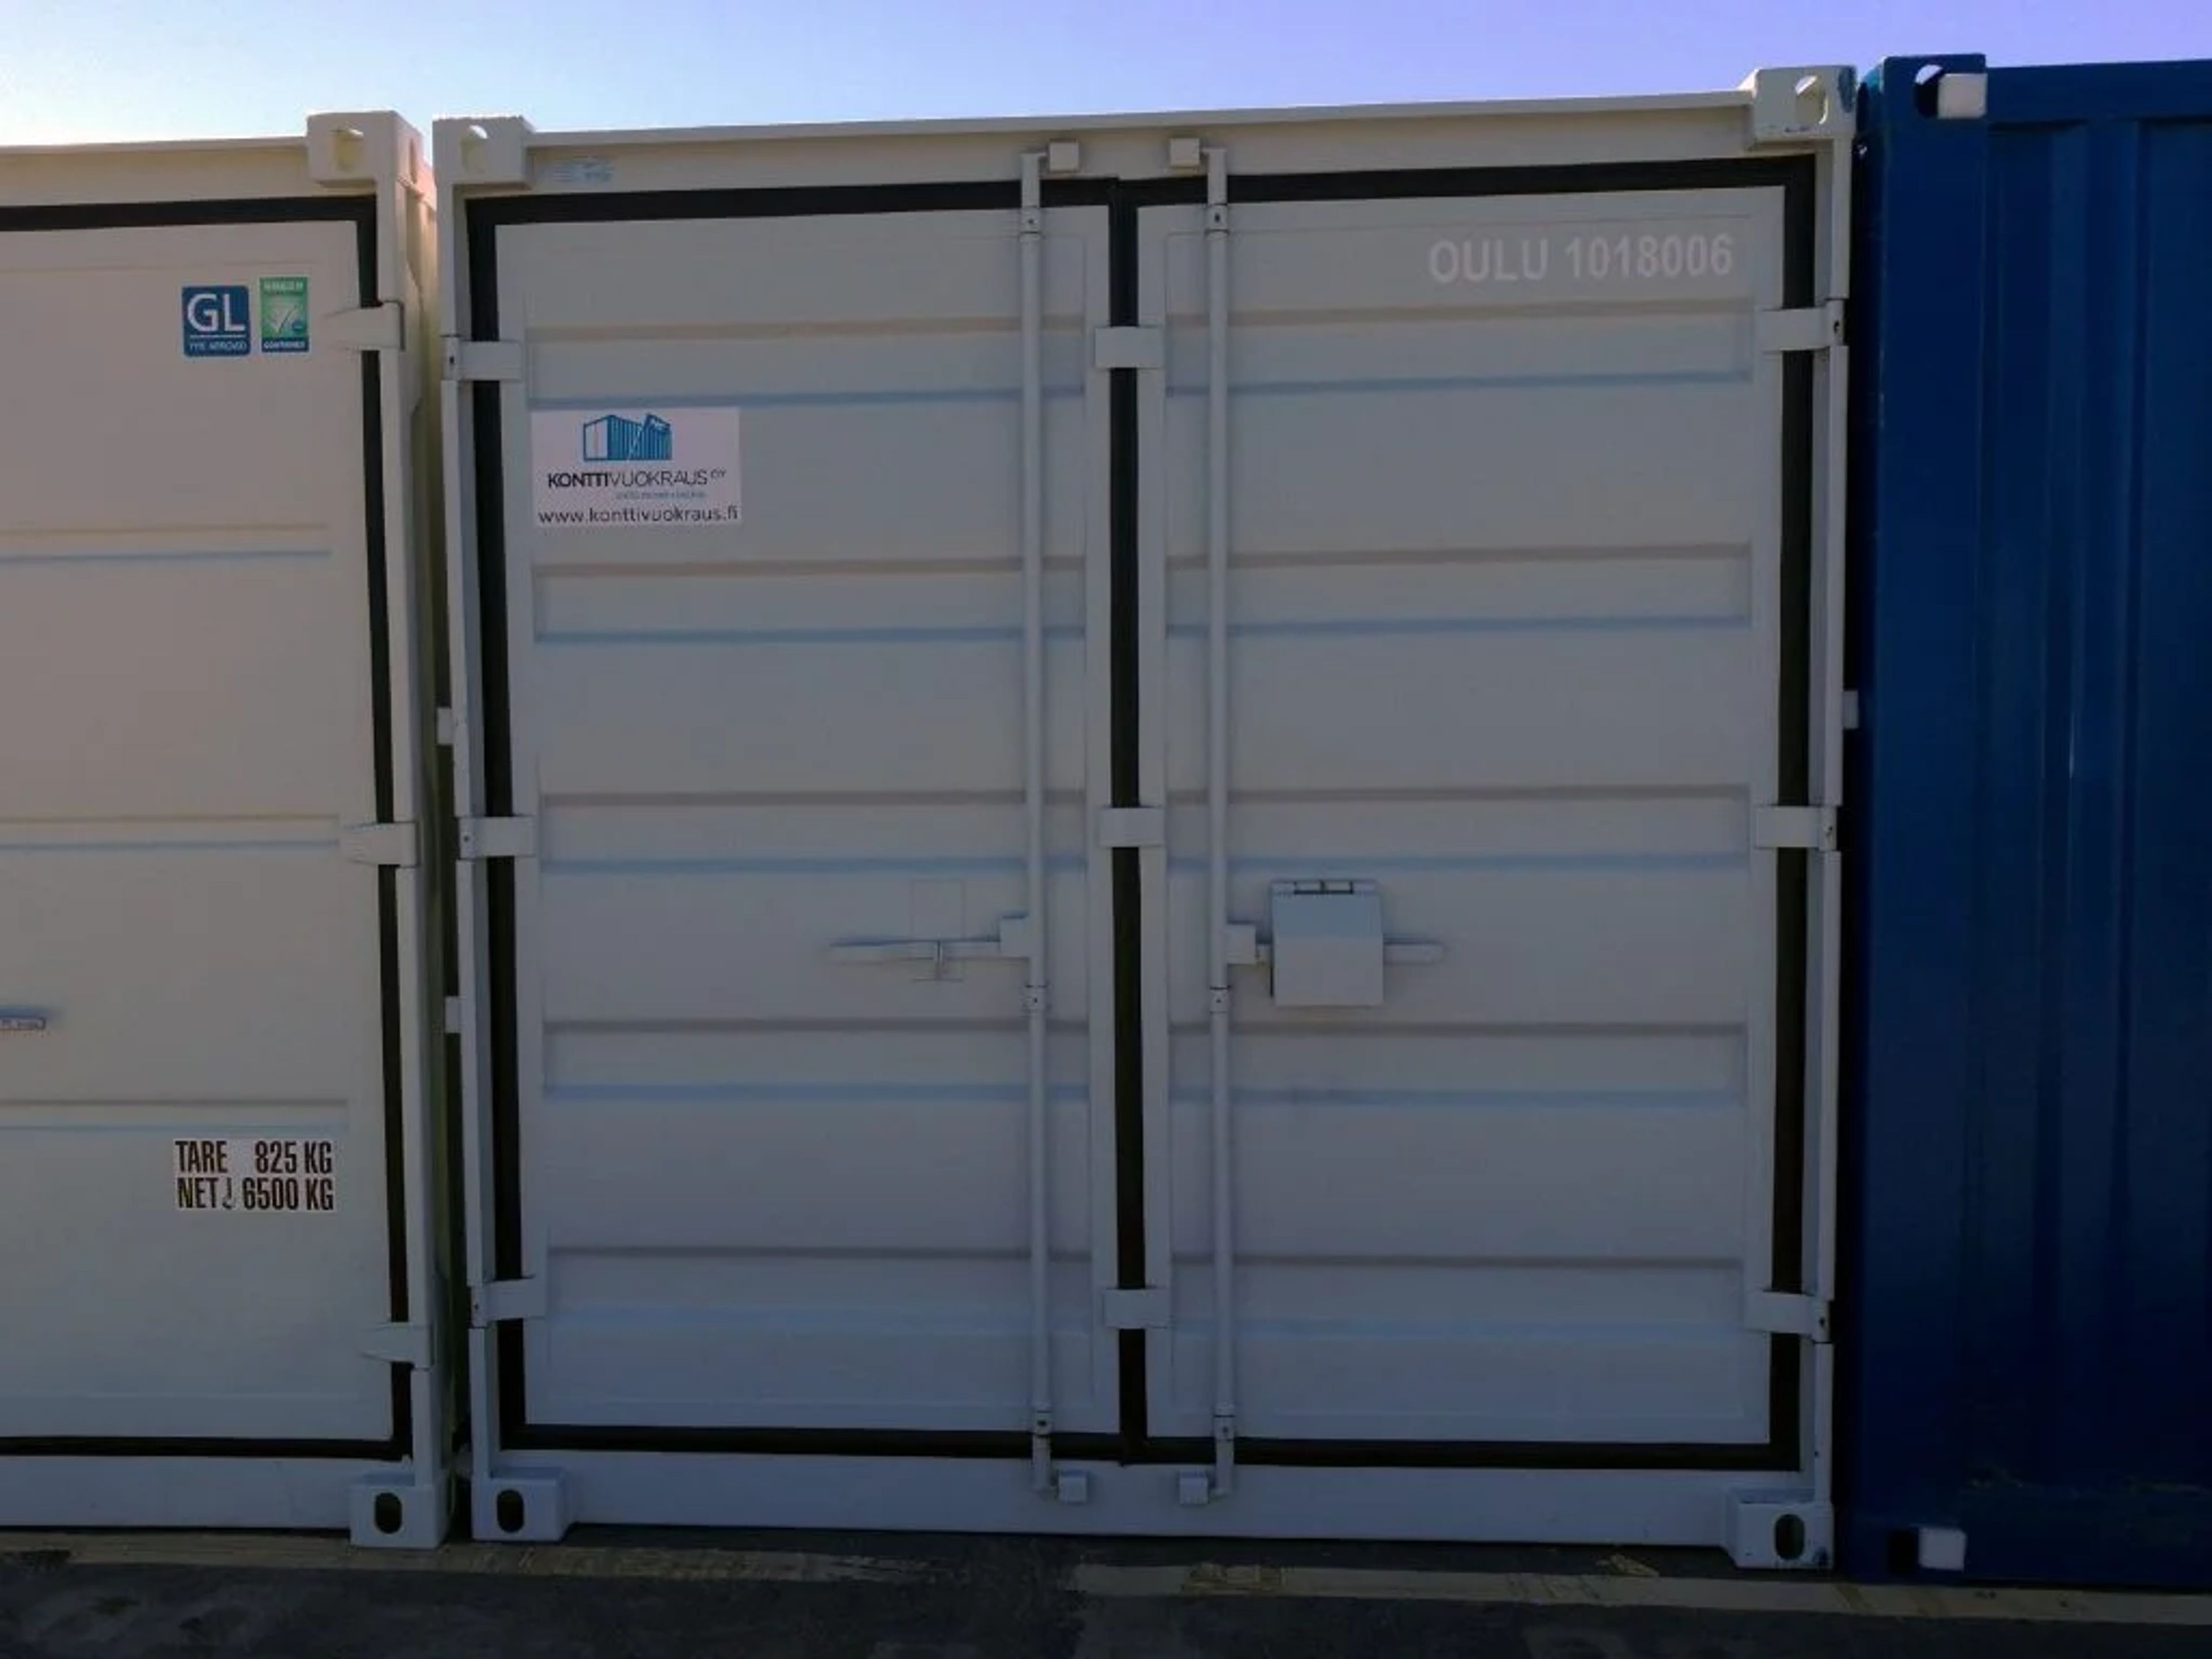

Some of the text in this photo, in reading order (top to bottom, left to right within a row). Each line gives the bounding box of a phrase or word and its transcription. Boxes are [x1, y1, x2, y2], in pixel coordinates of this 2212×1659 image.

[1429, 233, 1733, 283] OULU 1018006
[188, 293, 246, 332] GL
[538, 505, 738, 524] www.konttivuokraus.fi
[175, 1141, 332, 1173] TARE 825 KG
[177, 1177, 334, 1210] NET 6500 KG
